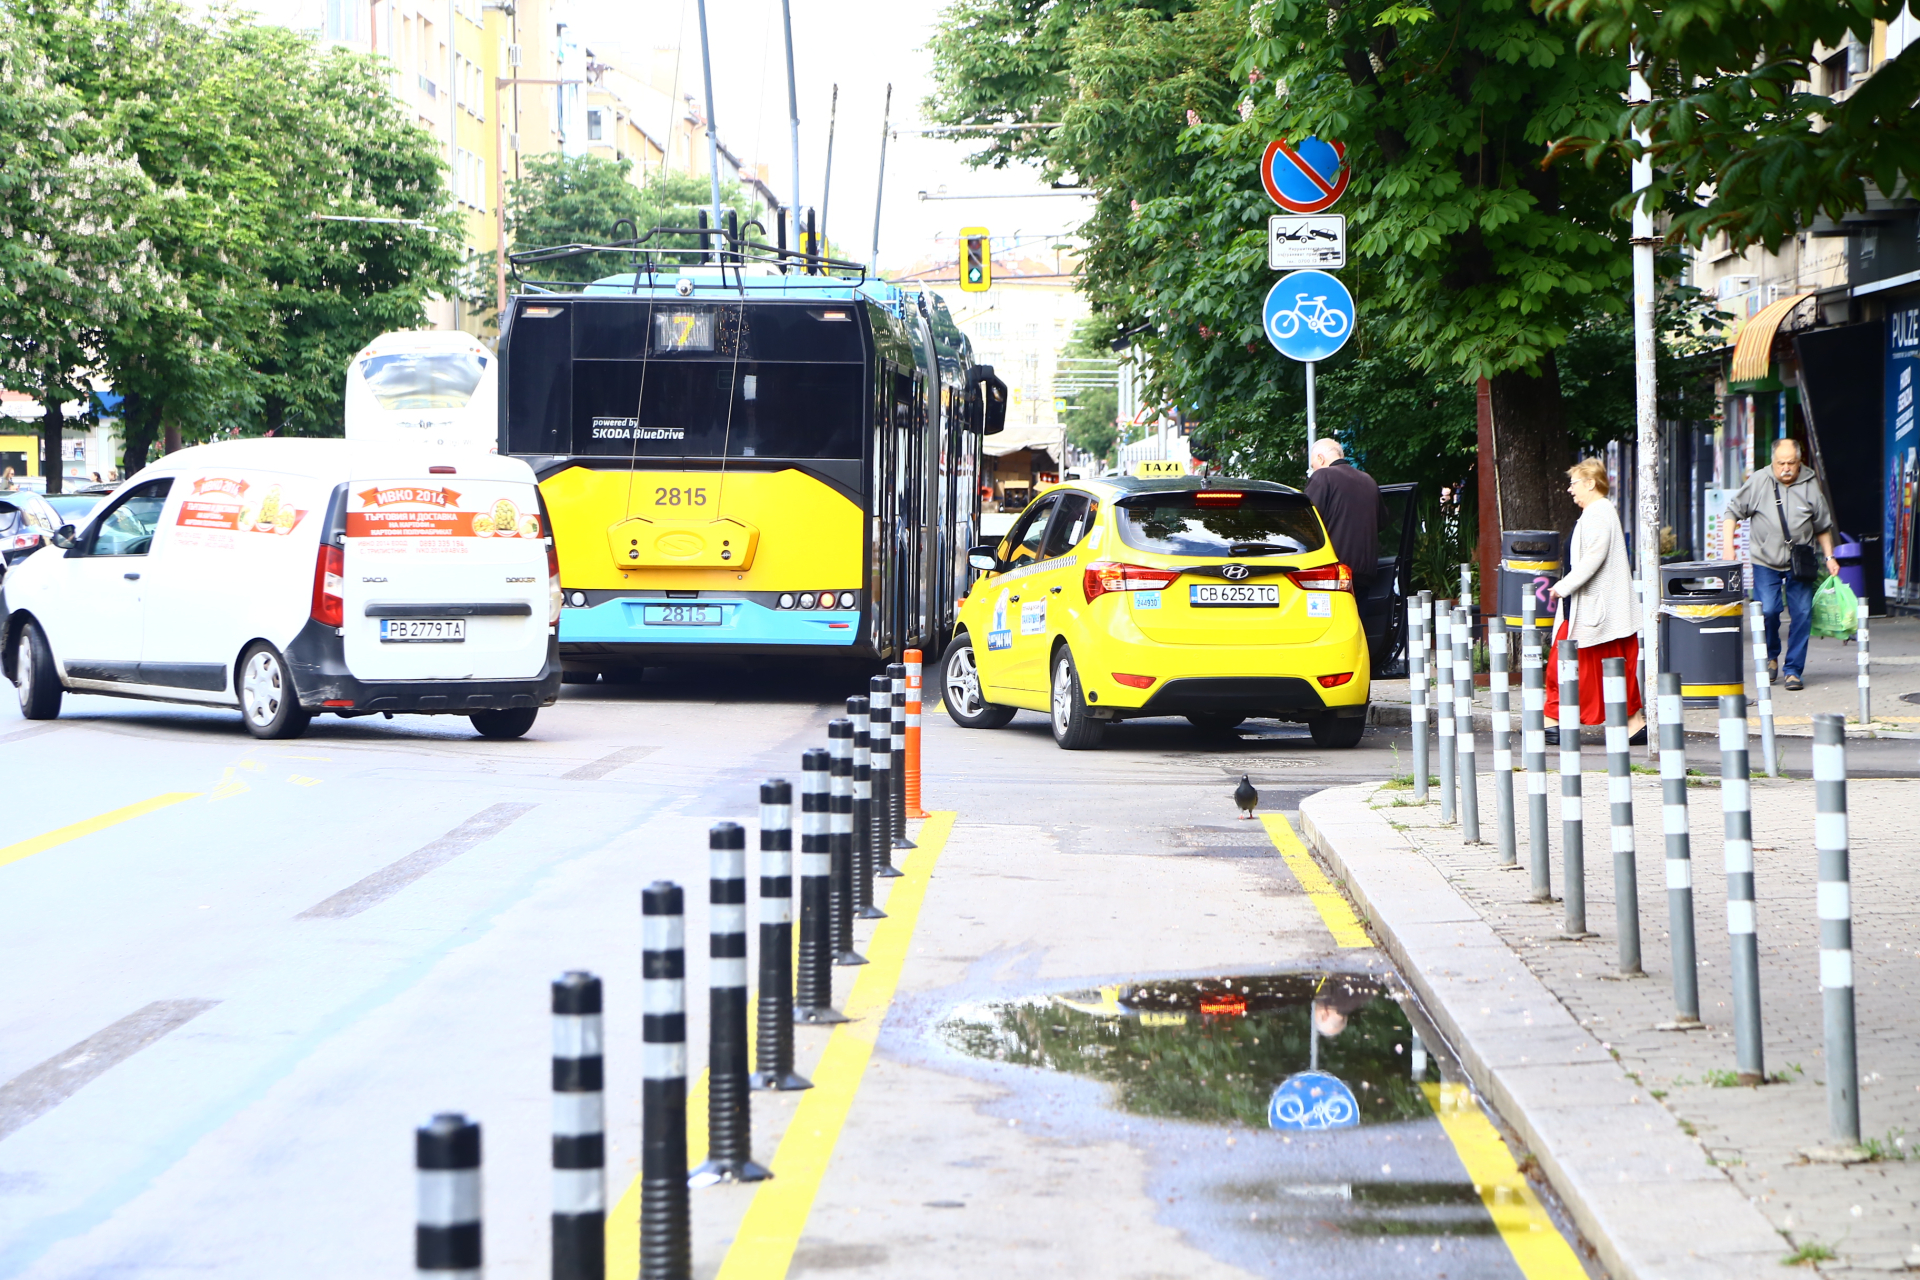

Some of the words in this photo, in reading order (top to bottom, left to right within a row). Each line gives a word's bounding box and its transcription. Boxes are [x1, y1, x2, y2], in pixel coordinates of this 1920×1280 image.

[673, 316, 695, 346] 7
[1892, 308, 1919, 348] PULZE
[592, 419, 627, 428] powered
[629, 418, 638, 428] by
[592, 428, 631, 439] SKODA
[633, 428, 685, 440] BlueDrive
[1143, 463, 1179, 471] TAXI
[376, 489, 413, 504] ИВКО
[416, 490, 445, 504] 2014
[655, 487, 707, 506] 2815
[364, 513, 408, 521] ТЪРГОВИЯ
[417, 513, 458, 521] ДОСТАВКА
[1199, 588, 1218, 602] CB
[1221, 588, 1255, 602] 6252
[1259, 588, 1276, 602] TC
[662, 606, 706, 622] 2815
[391, 622, 408, 636] PB
[411, 622, 442, 637] 2779
[445, 622, 461, 637] TA
